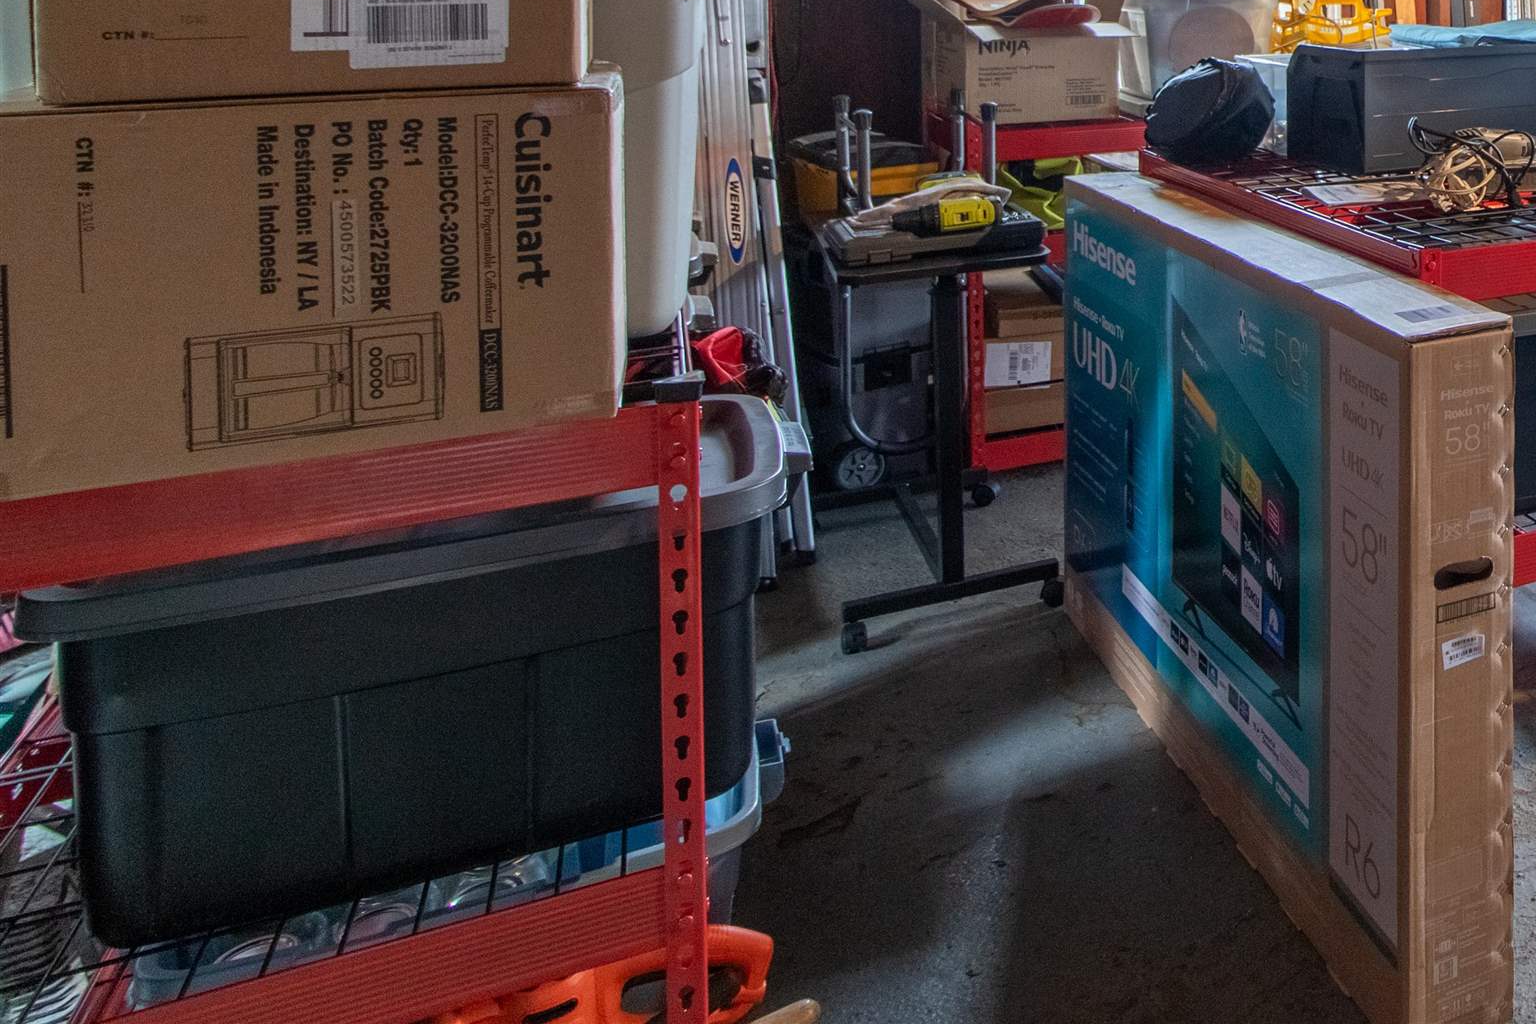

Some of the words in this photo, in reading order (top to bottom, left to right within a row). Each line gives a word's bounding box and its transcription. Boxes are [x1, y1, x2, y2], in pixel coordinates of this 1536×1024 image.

[102, 31, 134, 40] CTN
[978, 40, 1030, 58] NINJA
[257, 126, 278, 176] Made
[332, 122, 352, 147] PO
[368, 119, 388, 170] Batch
[400, 119, 422, 155] Qty:
[76, 138, 94, 172] CTN
[404, 159, 422, 167] 1
[258, 183, 278, 199] in
[294, 124, 316, 236] Destination:
[514, 111, 551, 288] Cuisinart
[729, 180, 741, 243] WERNER
[258, 206, 280, 294] Indonesia
[297, 242, 318, 267] NY
[339, 200, 355, 305] 4500573522
[1073, 220, 1137, 286] Hisense
[297, 286, 320, 311] LA
[1073, 296, 1099, 324] Hisense
[484, 333, 499, 409] DCC-3200NAS
[1073, 321, 1117, 391] UHD
[1120, 358, 1140, 408] 4K
[1339, 364, 1388, 408] Hisense
[1440, 384, 1495, 401] Hisense
[1342, 402, 1368, 431] Roku
[1369, 416, 1384, 440] TV
[1444, 407, 1473, 421] Roku
[1474, 402, 1491, 416] TV
[1445, 423, 1490, 455] 58"
[1342, 447, 1370, 480] UHD
[1342, 506, 1387, 585] 58"
[1345, 814, 1380, 899] R6
